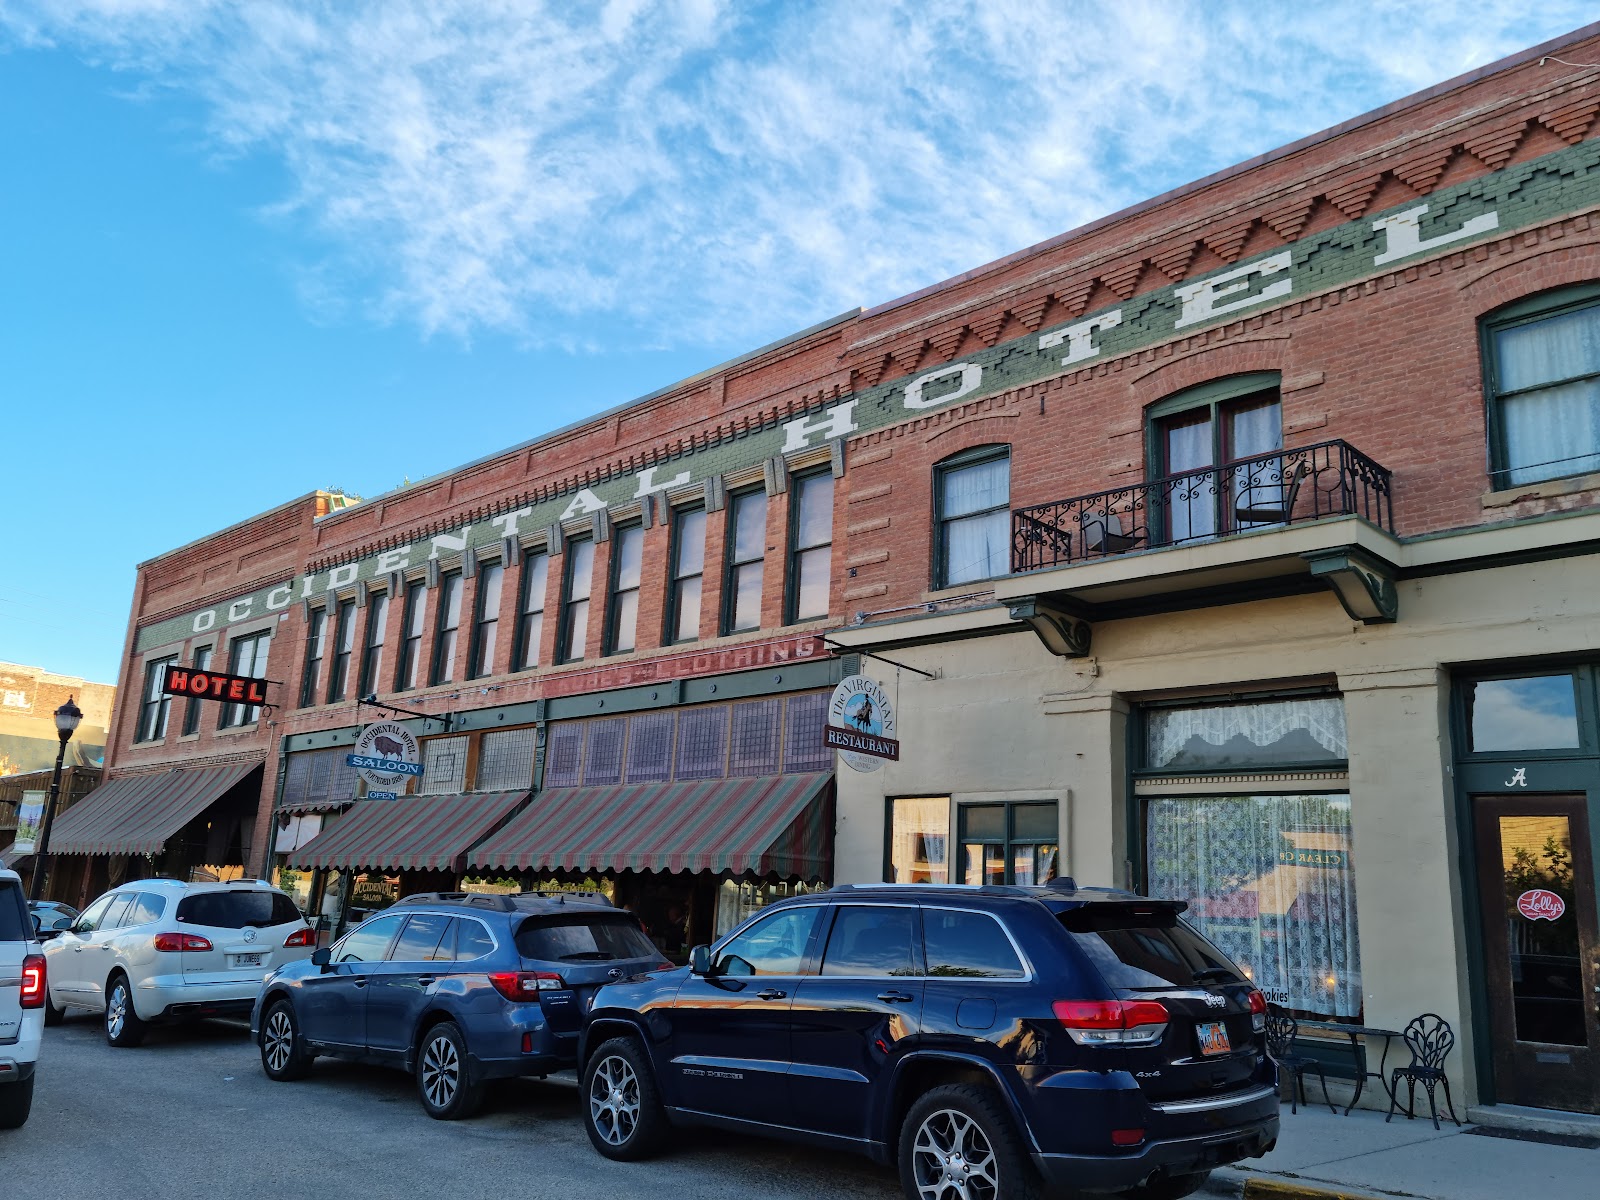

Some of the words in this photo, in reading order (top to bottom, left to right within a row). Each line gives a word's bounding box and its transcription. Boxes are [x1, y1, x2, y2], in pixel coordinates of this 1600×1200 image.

[192, 465, 692, 634] OCCIDENTAL
[781, 204, 1499, 454] HOTEL
[169, 669, 264, 702] HOTEL
[833, 693, 847, 718] The
[843, 678, 894, 732] VIRGINIAN
[361, 724, 400, 749] OCCIDENTAL
[400, 731, 416, 755] HOTEL
[828, 729, 897, 757] RESTAURANT
[352, 756, 419, 774] SALOON
[1504, 767, 1528, 787] A
[369, 791, 396, 800] OPEN
[362, 894, 383, 902] SALOON
[1520, 891, 1563, 916] Lolly's
[1205, 992, 1227, 1008] Jeep
